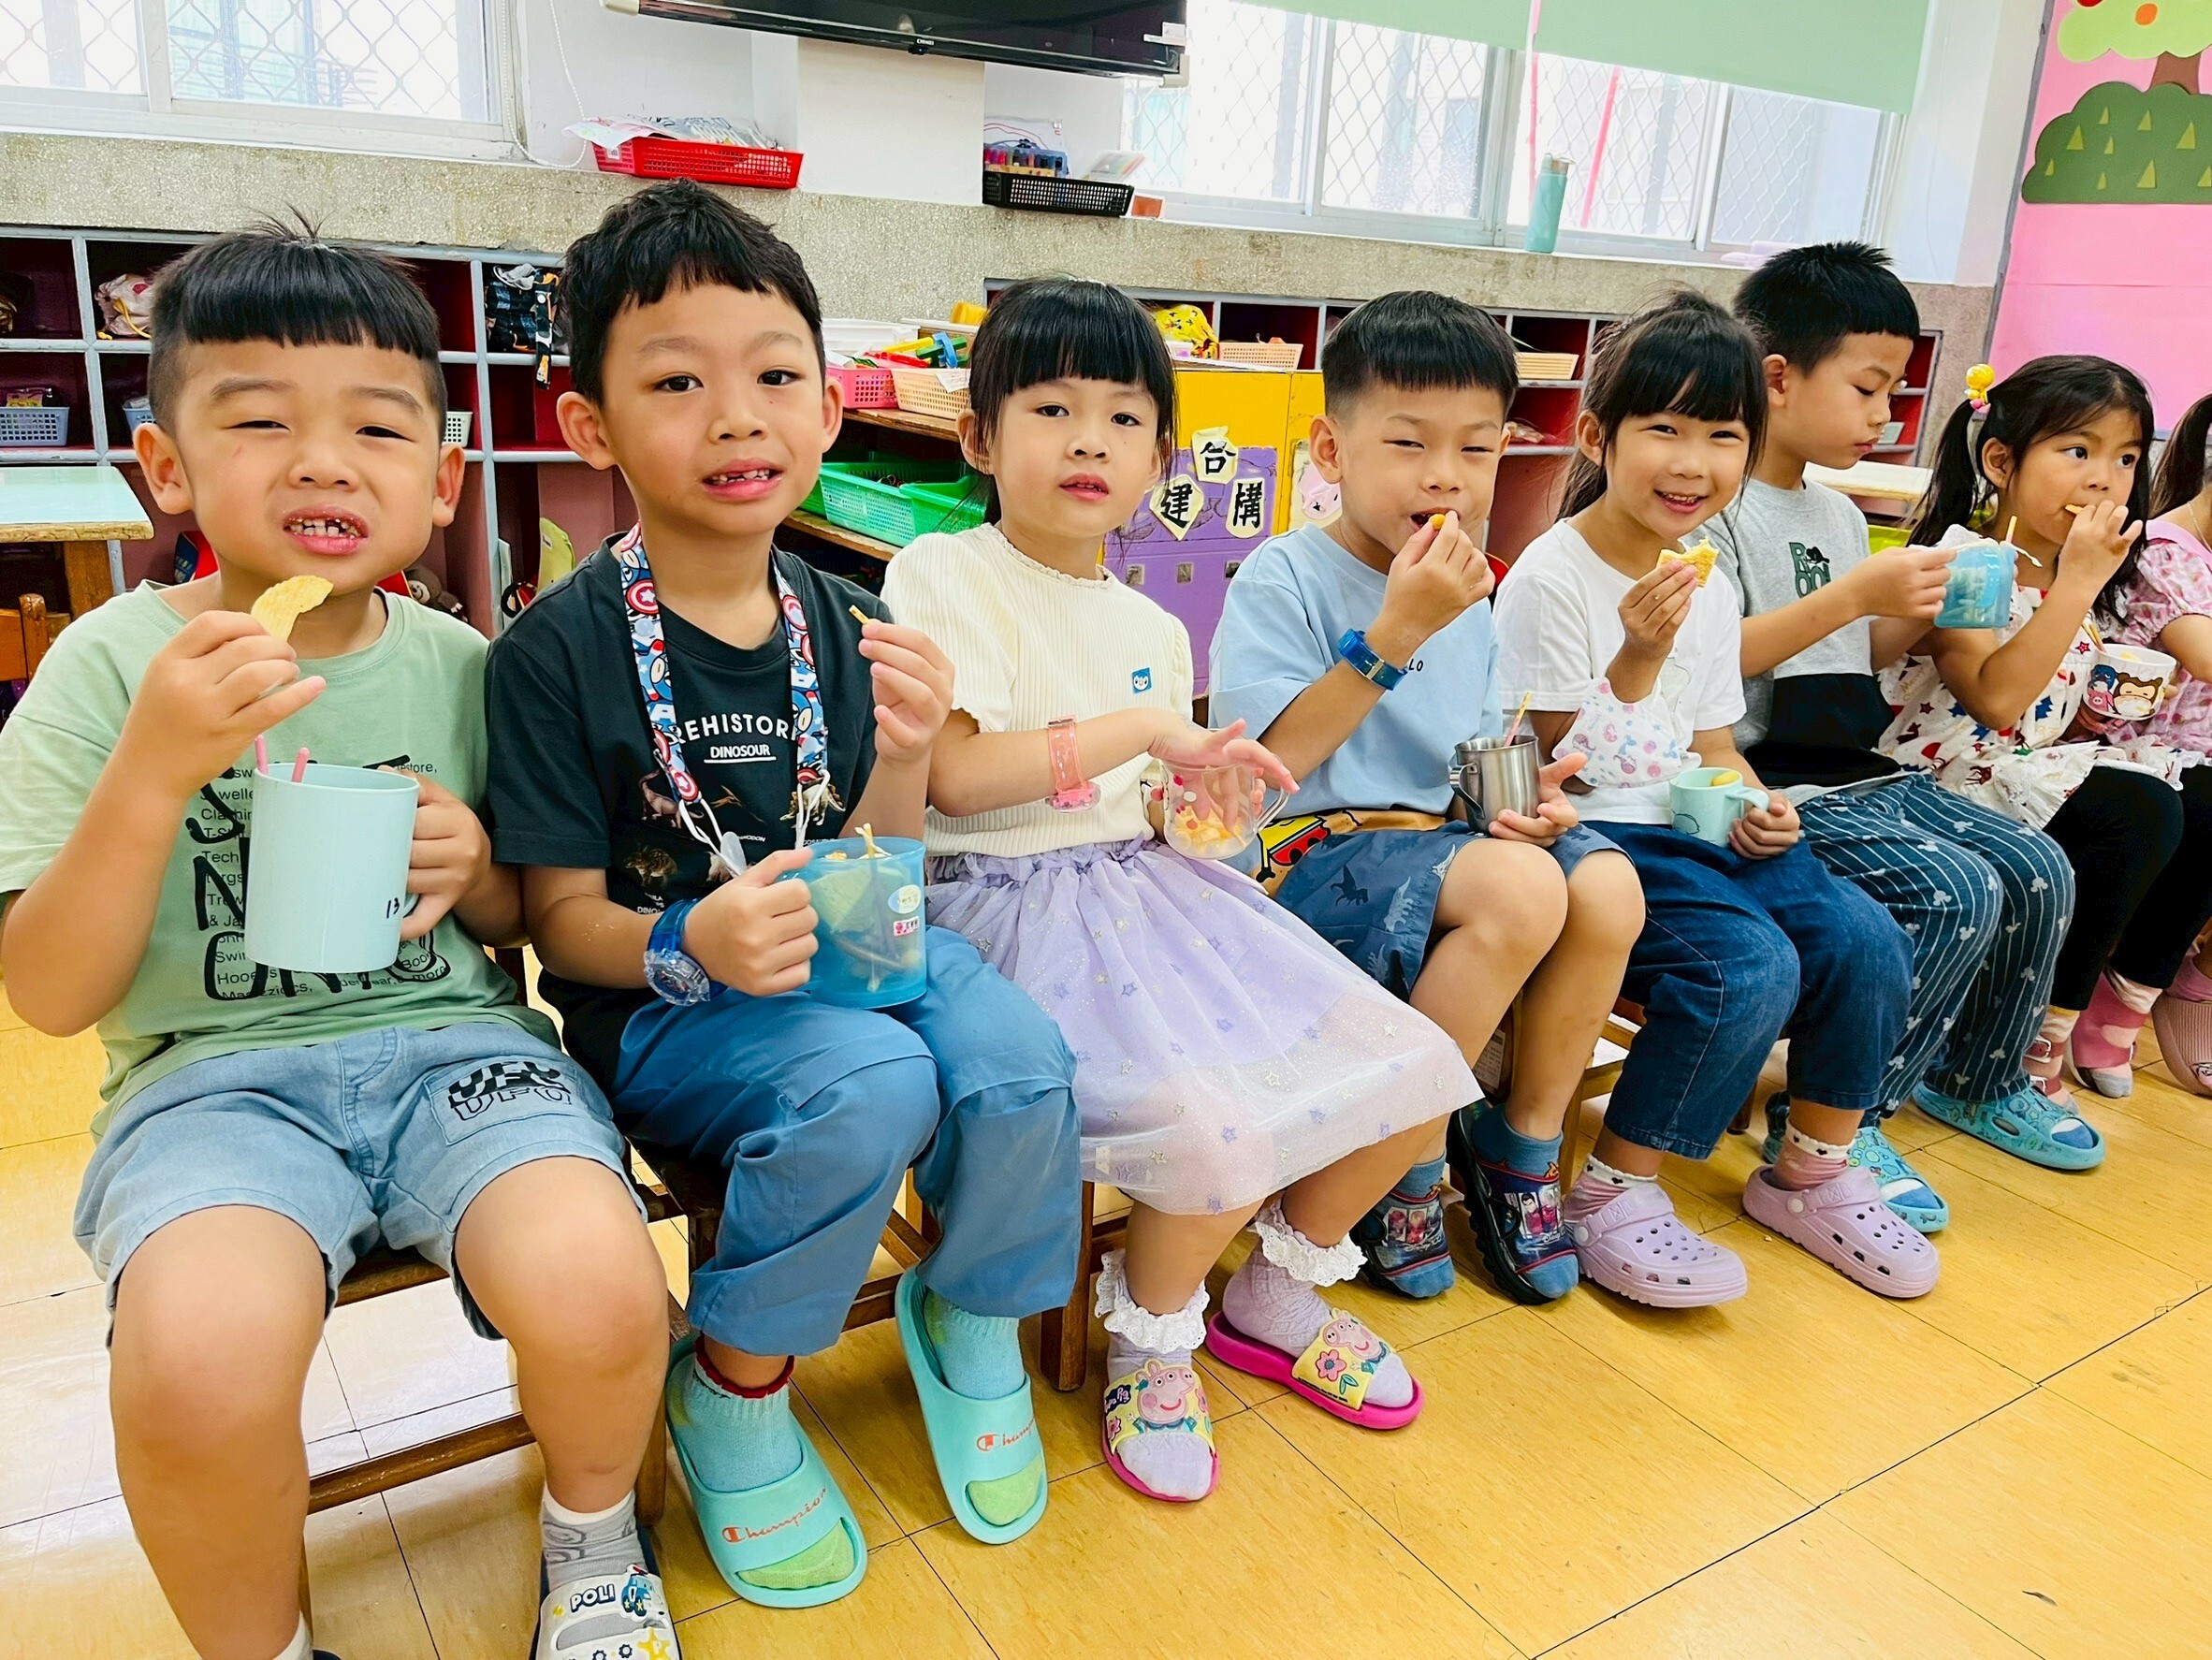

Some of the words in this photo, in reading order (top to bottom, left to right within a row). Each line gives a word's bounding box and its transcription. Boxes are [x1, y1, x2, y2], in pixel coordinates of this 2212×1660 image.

[1200, 441, 1236, 475] 合
[1160, 483, 1193, 529] 建
[1232, 480, 1262, 529] 構
[1408, 658, 1424, 672] LO
[668, 713, 796, 745] REHISTOR
[709, 744, 771, 759] DINOSOUR
[209, 914, 219, 926] &
[386, 896, 400, 919] 13
[569, 1583, 616, 1613] POLI
